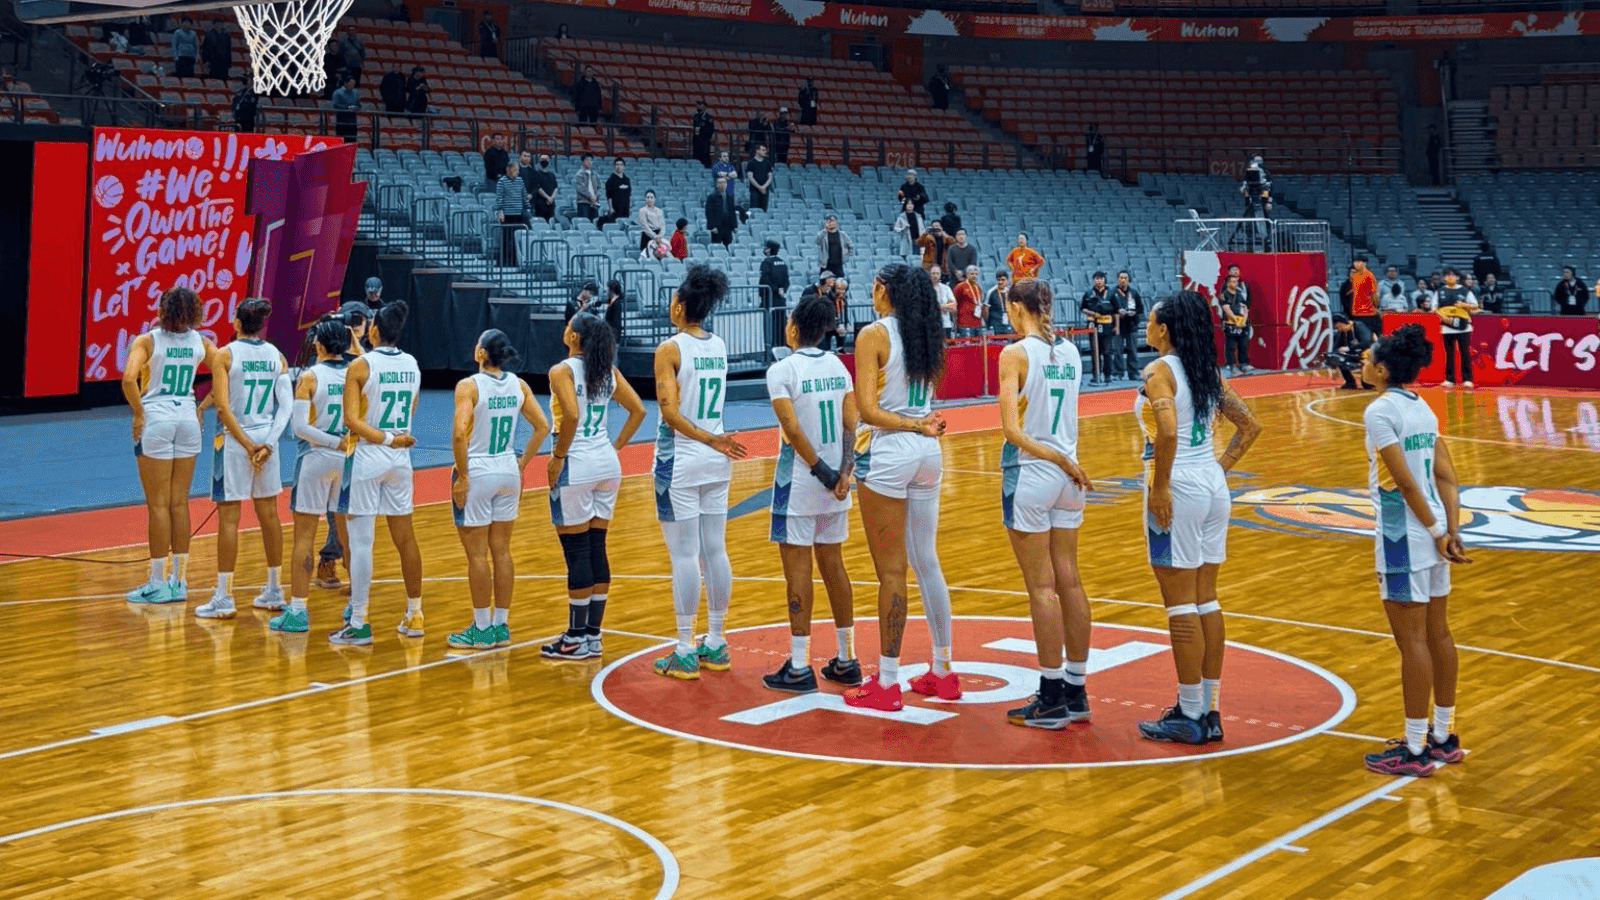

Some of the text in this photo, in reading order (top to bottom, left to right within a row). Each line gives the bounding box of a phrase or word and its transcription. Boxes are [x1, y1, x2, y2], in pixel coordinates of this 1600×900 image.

[698, 1, 752, 15] TOURNAMENT
[839, 8, 888, 27] Wuhan
[1180, 22, 1239, 37] Wuhan
[1353, 24, 1482, 36] QUALIFYING TOURNAMENT
[94, 132, 184, 162] Wuhan
[884, 152, 915, 168] C216
[1210, 161, 1245, 176] C217
[135, 164, 214, 205] #We
[124, 197, 234, 243] Own The
[135, 227, 230, 275] Game!
[166, 347, 193, 359] MOURA
[1495, 332, 1600, 372] LET'S
[241, 360, 276, 373] SANGALLI
[693, 356, 726, 371] D.DANTAS
[1042, 363, 1076, 380] VAREJÃO
[160, 364, 194, 396] 90
[378, 371, 416, 385] NICOLETTI
[801, 376, 846, 394] DE OLIVEIRA
[243, 378, 273, 415] 77
[327, 383, 344, 396] GON
[697, 377, 722, 420] 12
[378, 390, 412, 429] 23
[488, 395, 518, 410] DÉBORA
[1049, 388, 1066, 435] 7
[327, 403, 346, 434] 2
[818, 400, 836, 444] 11
[488, 415, 513, 455] 18
[1404, 433, 1436, 452] NASC
